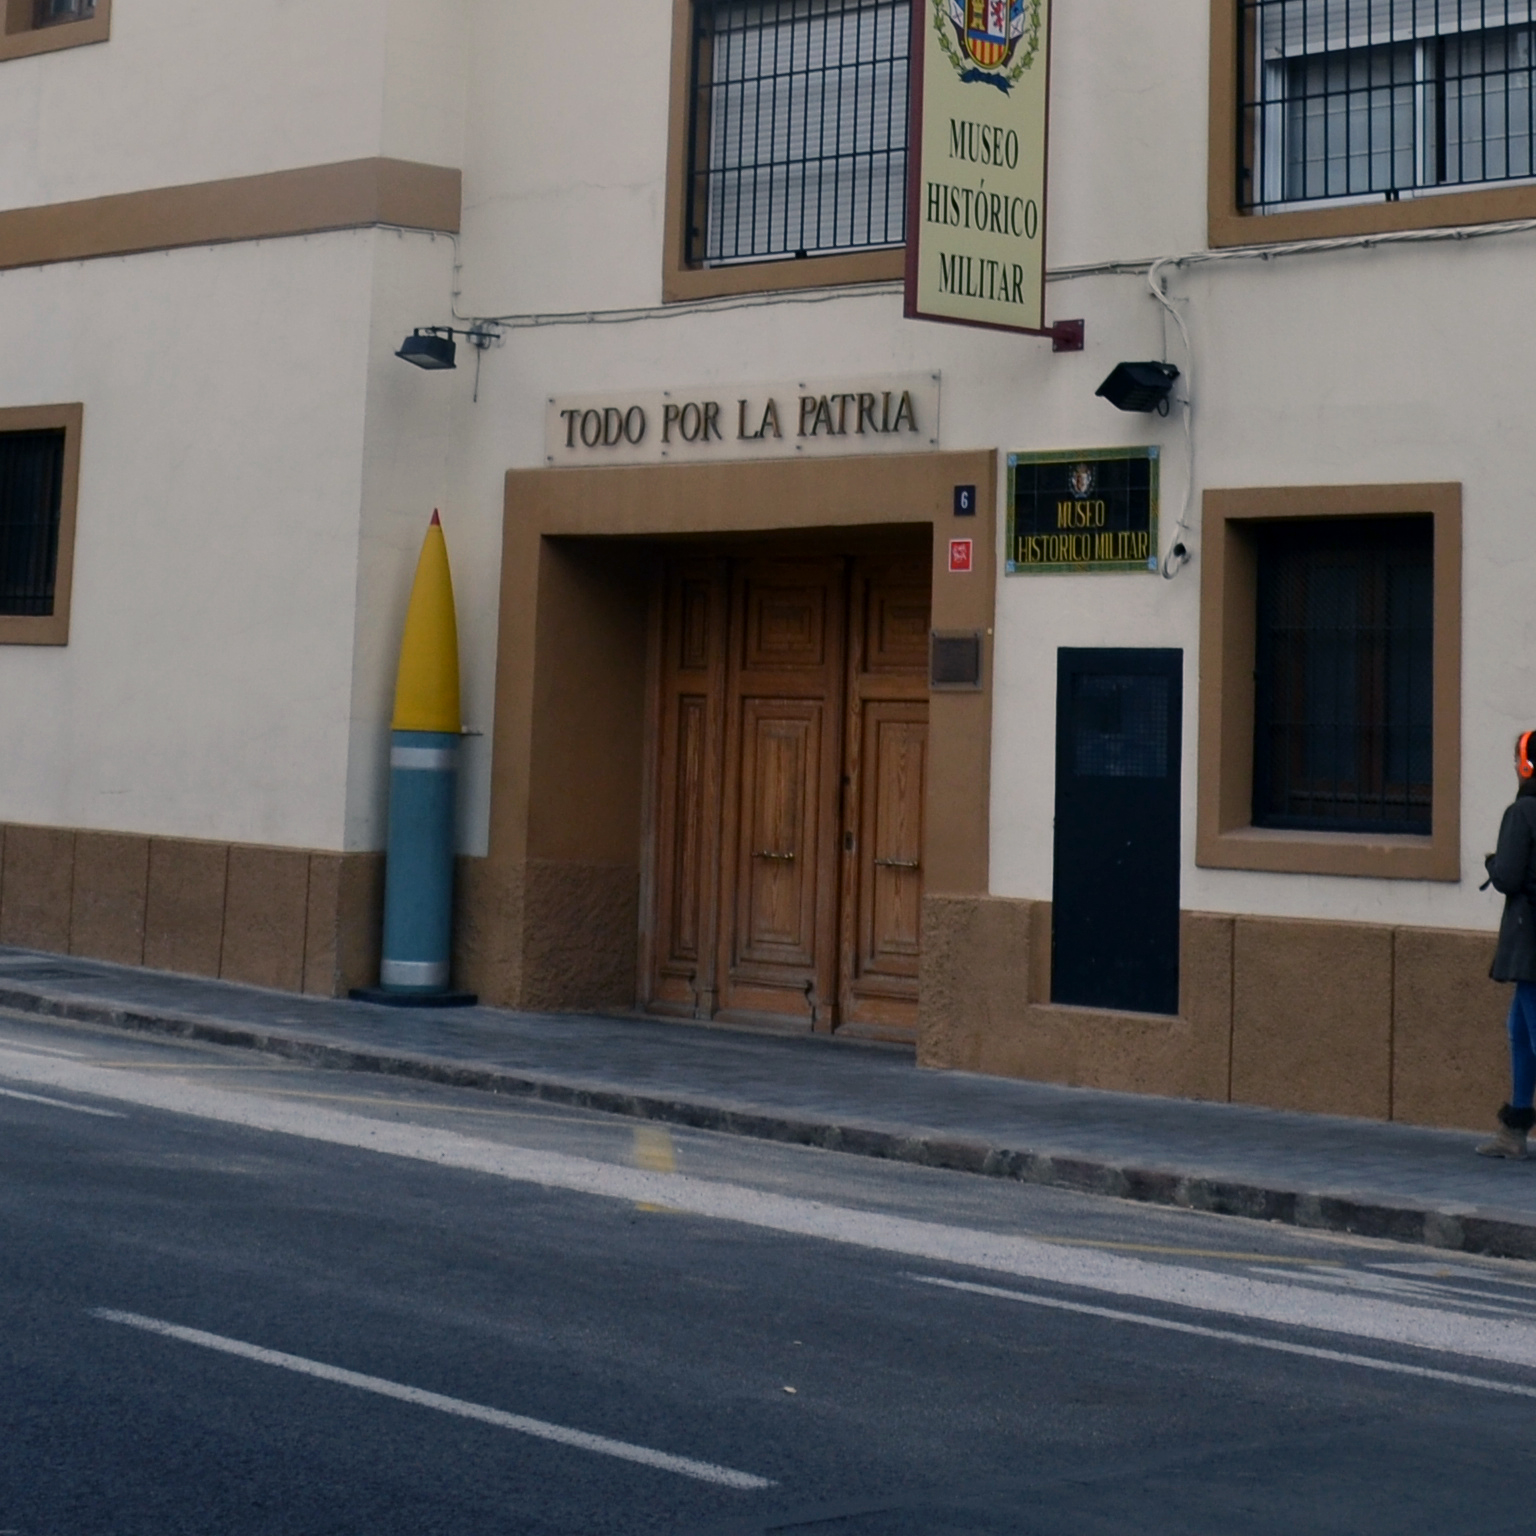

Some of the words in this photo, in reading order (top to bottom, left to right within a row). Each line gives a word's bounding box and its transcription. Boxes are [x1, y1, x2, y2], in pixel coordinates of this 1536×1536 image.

[949, 118, 1019, 170] MUSEO
[927, 178, 1038, 240] HISTÓRICO
[938, 252, 1024, 304] MILITAR
[560, 405, 646, 448] TODO
[660, 401, 723, 443] POR
[735, 397, 782, 440] LA
[796, 390, 918, 437] PATRIA
[960, 491, 969, 509] 6
[1057, 500, 1105, 529] MUSEO
[1018, 534, 1091, 562] HISTORICO
[1095, 531, 1148, 560] MILITAR
